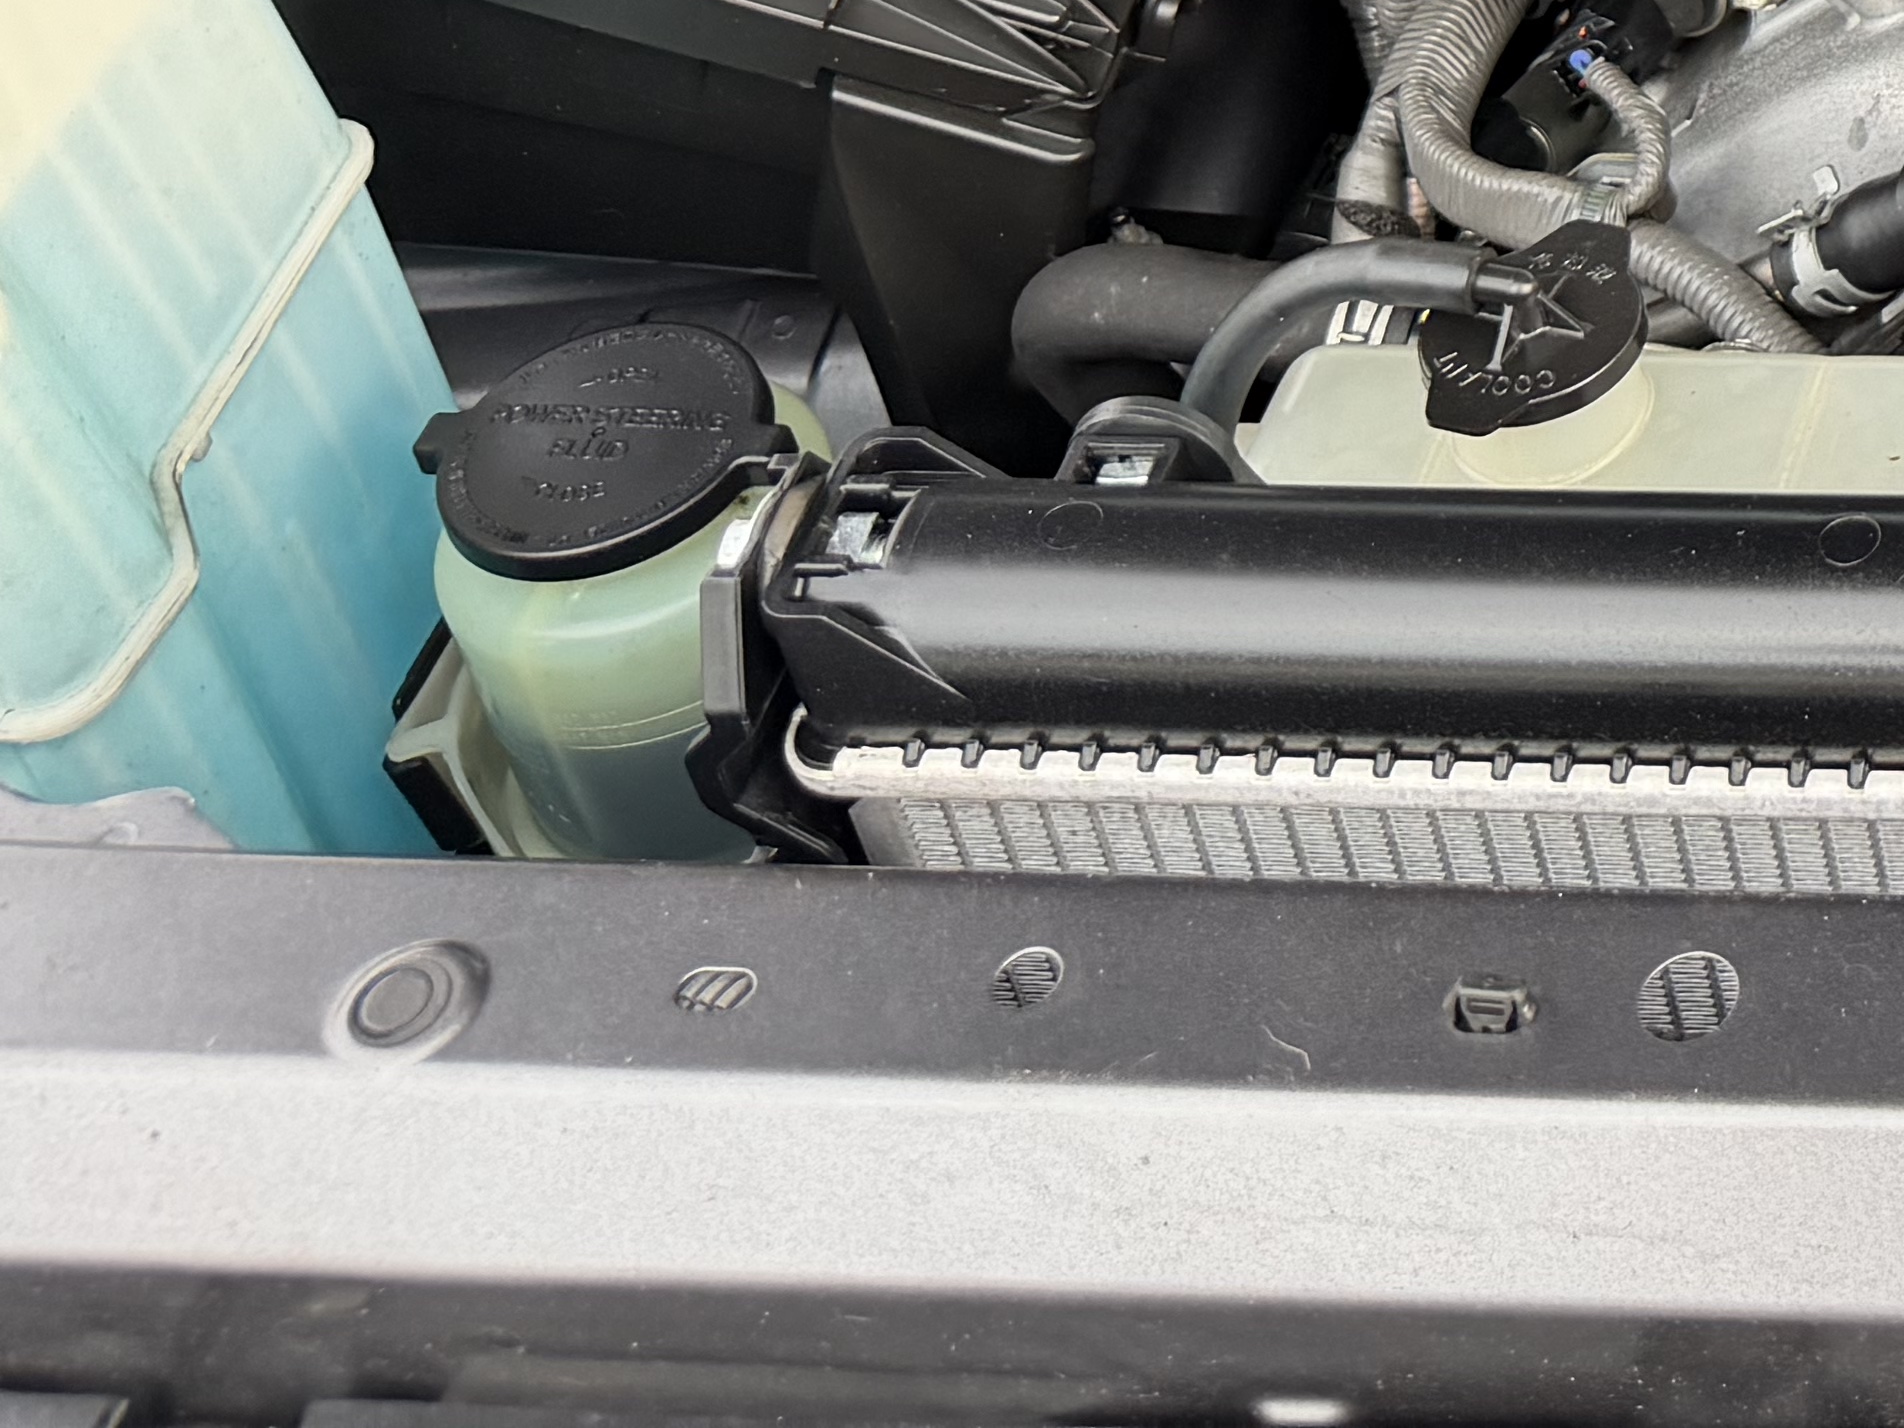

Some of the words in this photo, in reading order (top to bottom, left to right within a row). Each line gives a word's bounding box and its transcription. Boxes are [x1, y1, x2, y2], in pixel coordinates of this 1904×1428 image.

[490, 402, 591, 424] POWER
[594, 406, 732, 432] STEERING
[550, 438, 630, 462] FLUID
